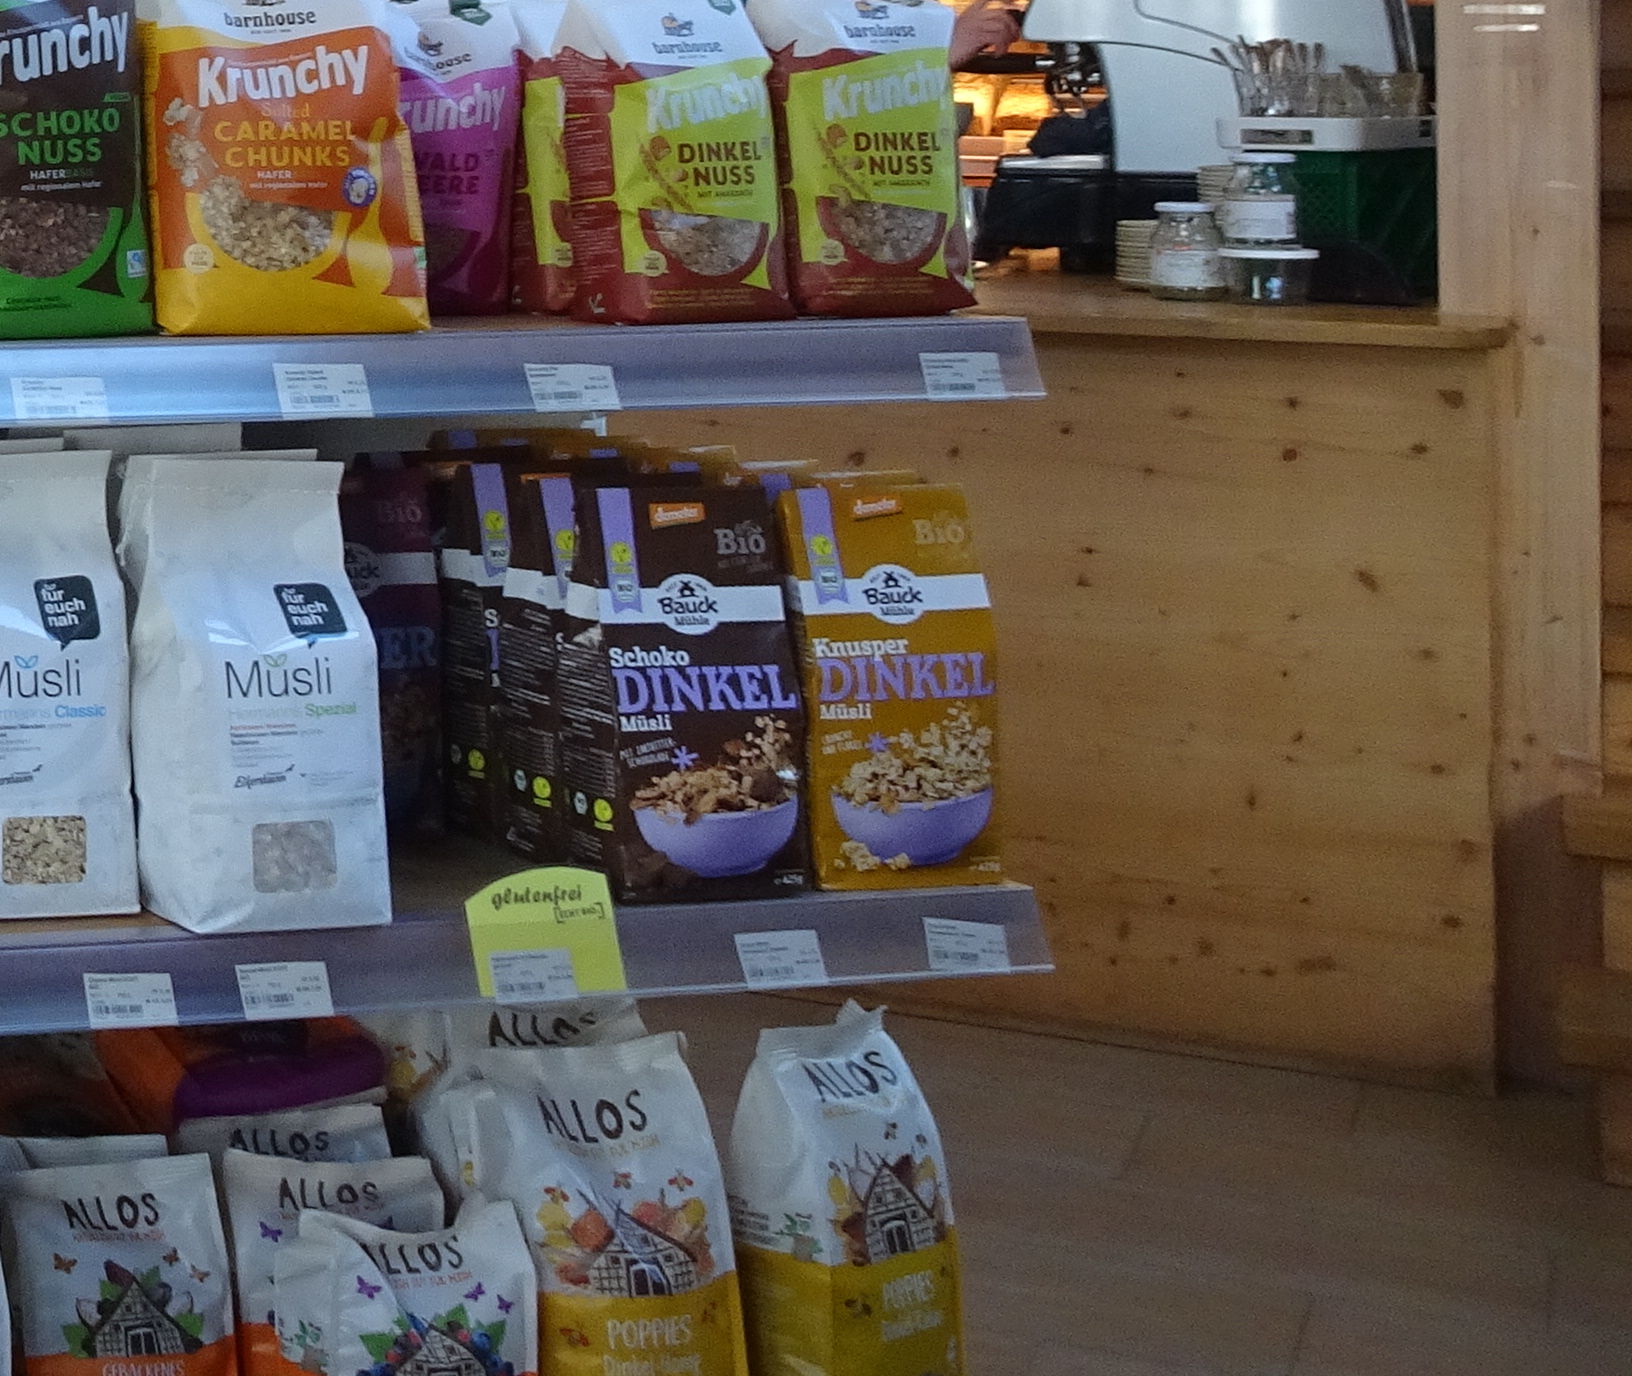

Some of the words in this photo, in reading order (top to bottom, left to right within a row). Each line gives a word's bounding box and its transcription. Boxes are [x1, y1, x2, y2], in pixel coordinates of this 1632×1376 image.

[198, 44, 369, 109] Krunchy
[822, 58, 949, 118] Krunchy
[646, 74, 765, 134] Krunchy
[213, 118, 357, 143] CARAMEL
[853, 129, 941, 156] DINKEL
[16, 137, 103, 165] NUSS
[223, 144, 350, 168] CHUNKS
[677, 138, 762, 165] DINKEL
[694, 161, 756, 189] NUSS
[869, 152, 935, 177] NUSS
[40, 583, 67, 604] für
[44, 596, 86, 615] euch
[658, 594, 719, 615] Bauck
[862, 585, 923, 607] Bauck
[47, 611, 80, 629] nah
[673, 613, 711, 627] Mühle
[878, 604, 916, 618] Mühle
[609, 646, 691, 669] Schoko
[813, 636, 910, 660] Knusper
[224, 653, 333, 701] Müsli
[615, 664, 797, 713] DINKEL
[817, 651, 996, 704] DINKEL
[54, 702, 108, 719] Classic
[304, 700, 358, 720] Spezial
[820, 703, 873, 721] Müsli
[620, 714, 672, 734] Müsli
[491, 885, 583, 910] glutenfrei
[803, 1050, 896, 1105] ALLOS
[539, 1089, 648, 1145] ALLOS
[278, 1176, 380, 1212] ALLOS
[61, 1191, 159, 1230] ALLOS
[606, 1312, 693, 1350] POPPIES
